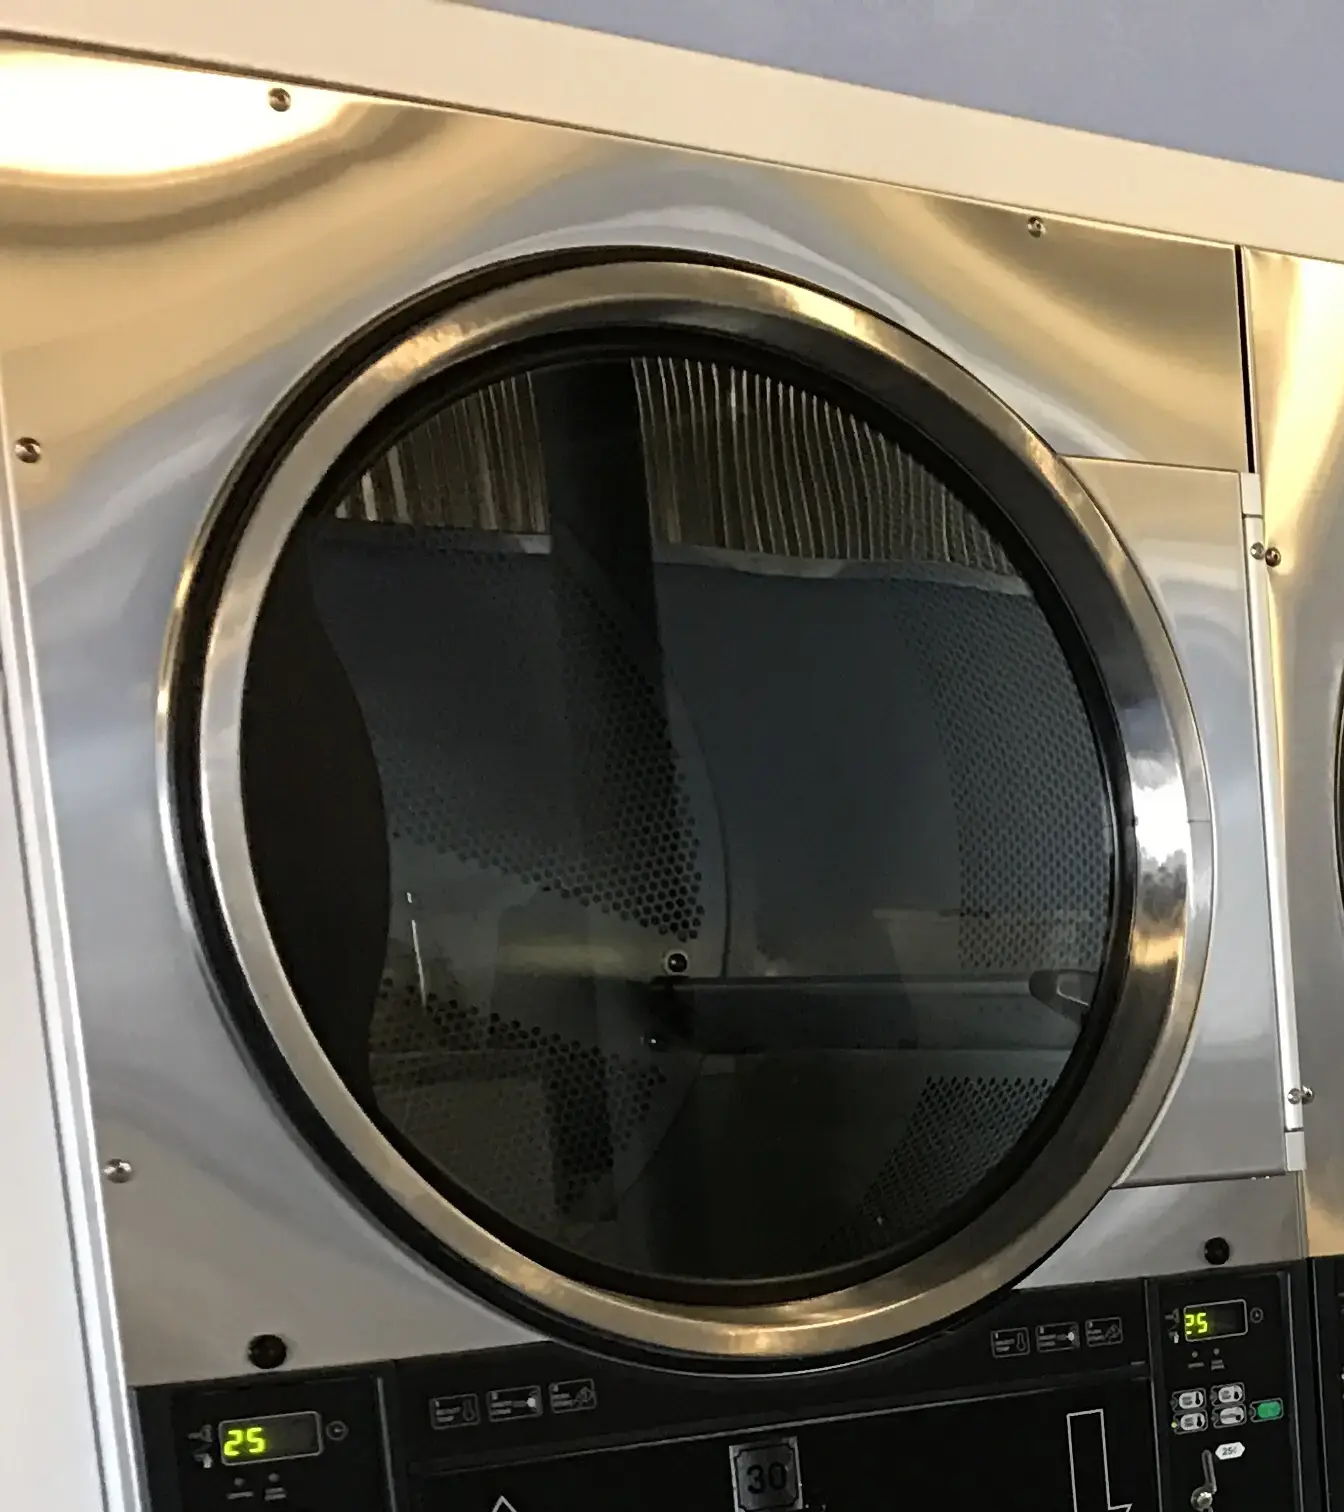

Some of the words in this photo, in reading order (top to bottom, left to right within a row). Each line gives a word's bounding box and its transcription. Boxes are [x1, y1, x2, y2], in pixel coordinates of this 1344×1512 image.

[1185, 1312, 1208, 1335] 25
[223, 1427, 266, 1457] 25
[746, 1461, 788, 1494] 30
